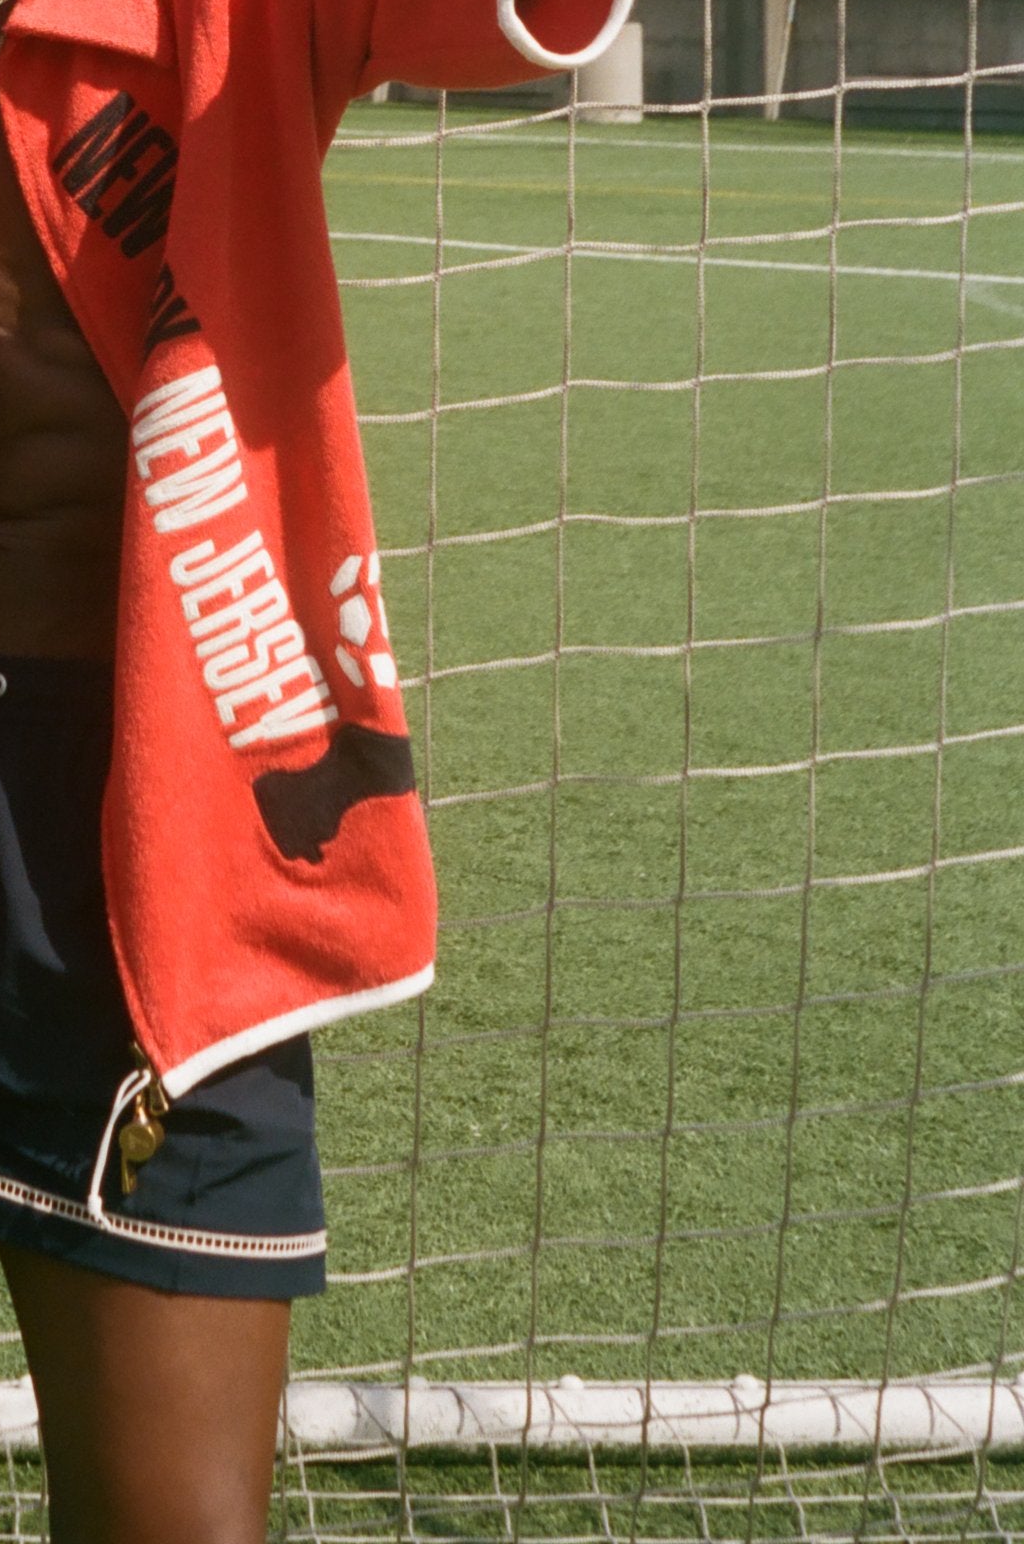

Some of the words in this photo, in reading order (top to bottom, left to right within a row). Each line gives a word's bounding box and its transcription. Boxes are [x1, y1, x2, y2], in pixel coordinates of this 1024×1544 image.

[51, 90, 179, 258] NEW
[133, 364, 247, 535] NEW
[171, 530, 338, 748] JERSEY
